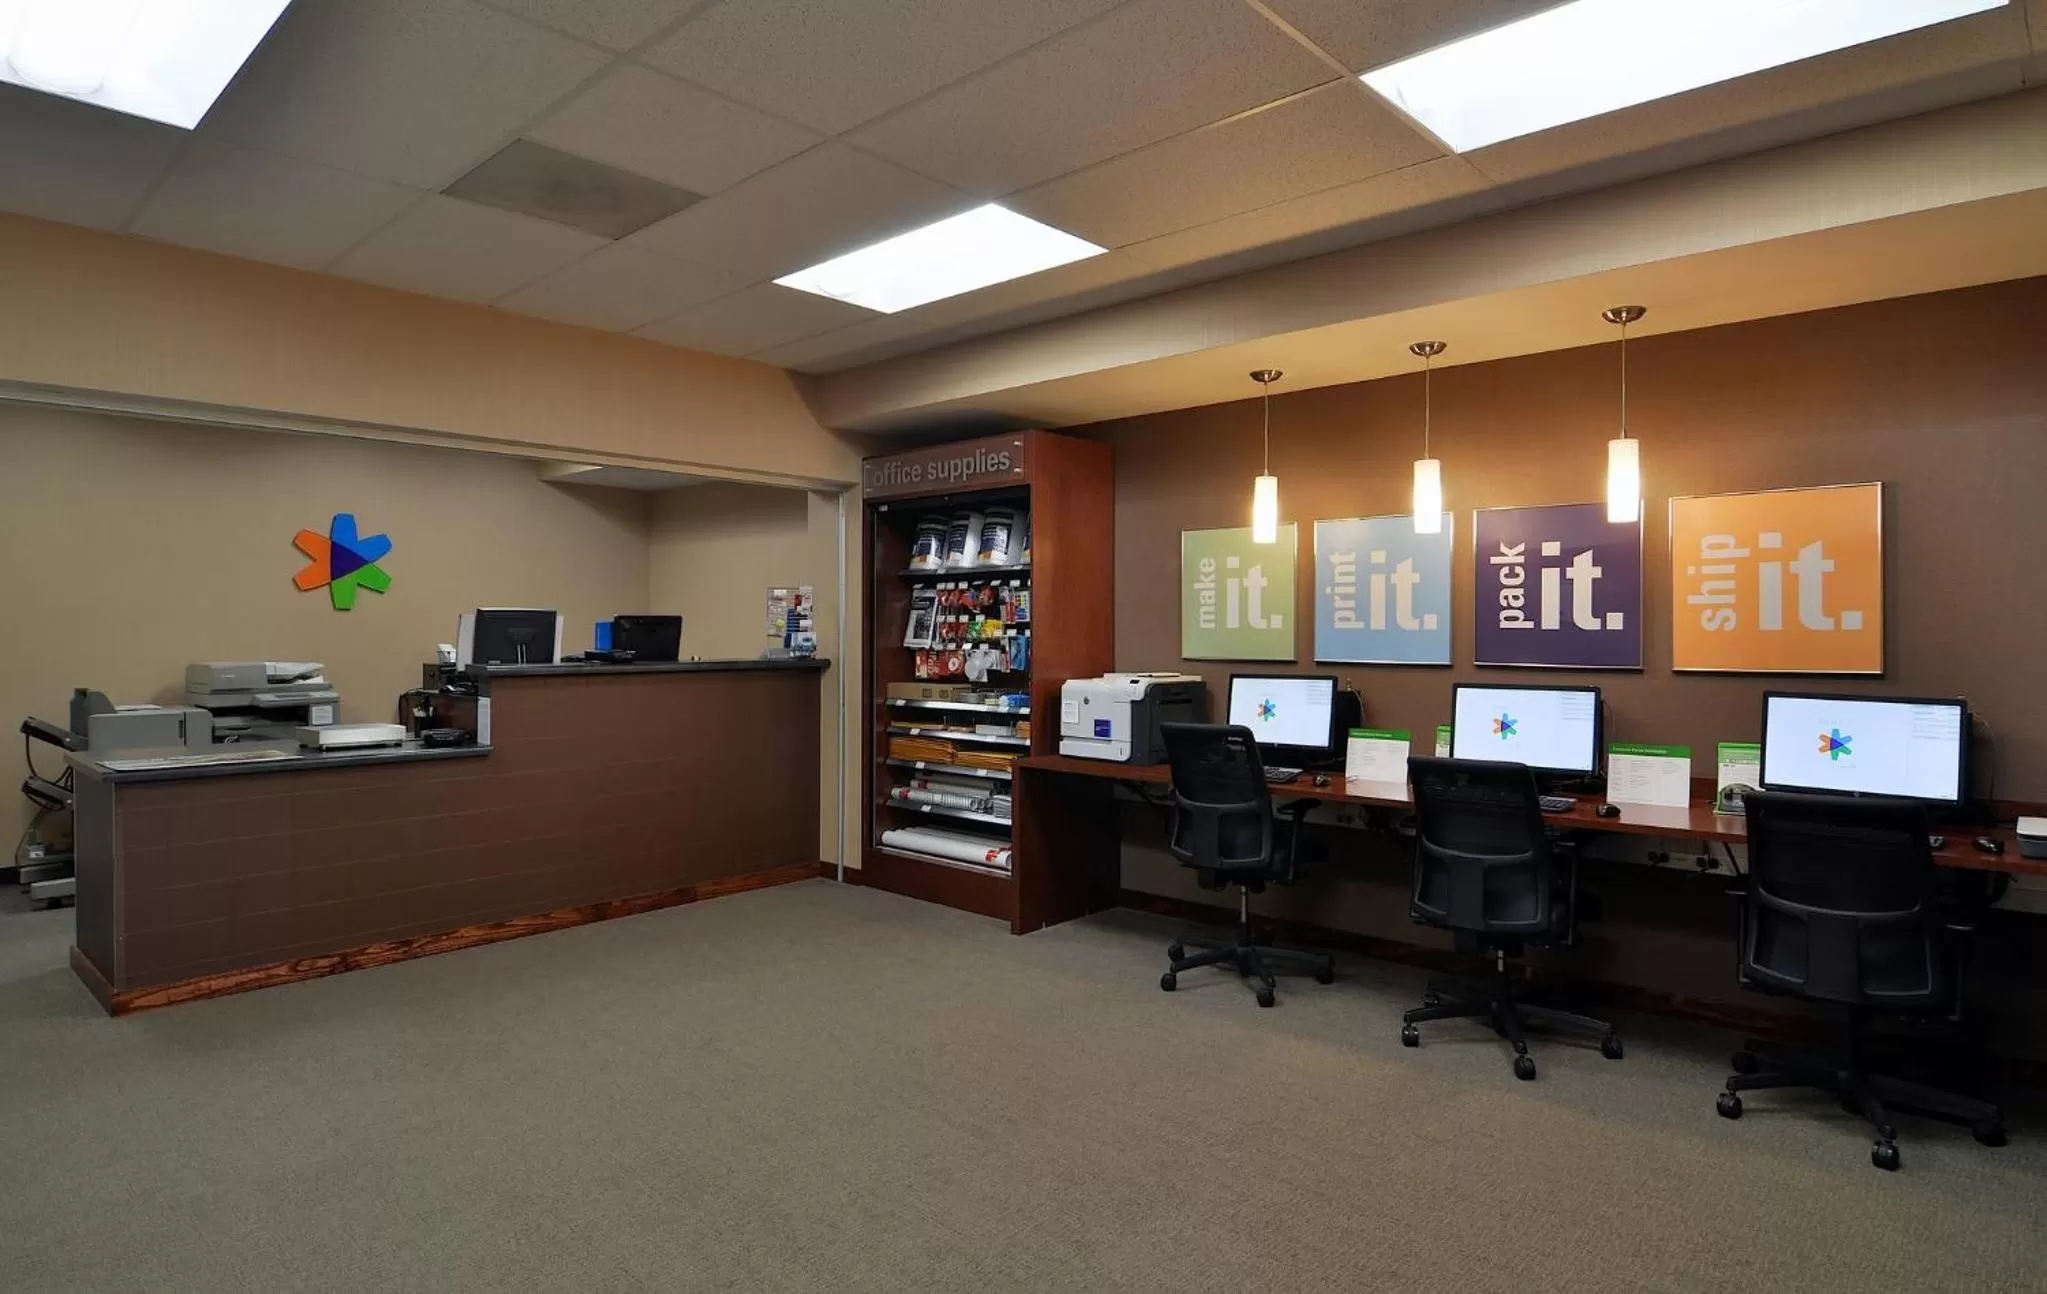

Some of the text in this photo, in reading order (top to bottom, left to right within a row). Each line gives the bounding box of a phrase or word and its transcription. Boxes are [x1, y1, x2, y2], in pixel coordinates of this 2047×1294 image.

[874, 448, 1011, 486] office supplies
[1194, 556, 1283, 630] make it.
[1326, 550, 1438, 631] print it.
[1490, 541, 1624, 630] pack it.
[1687, 532, 1862, 631] ship it.
